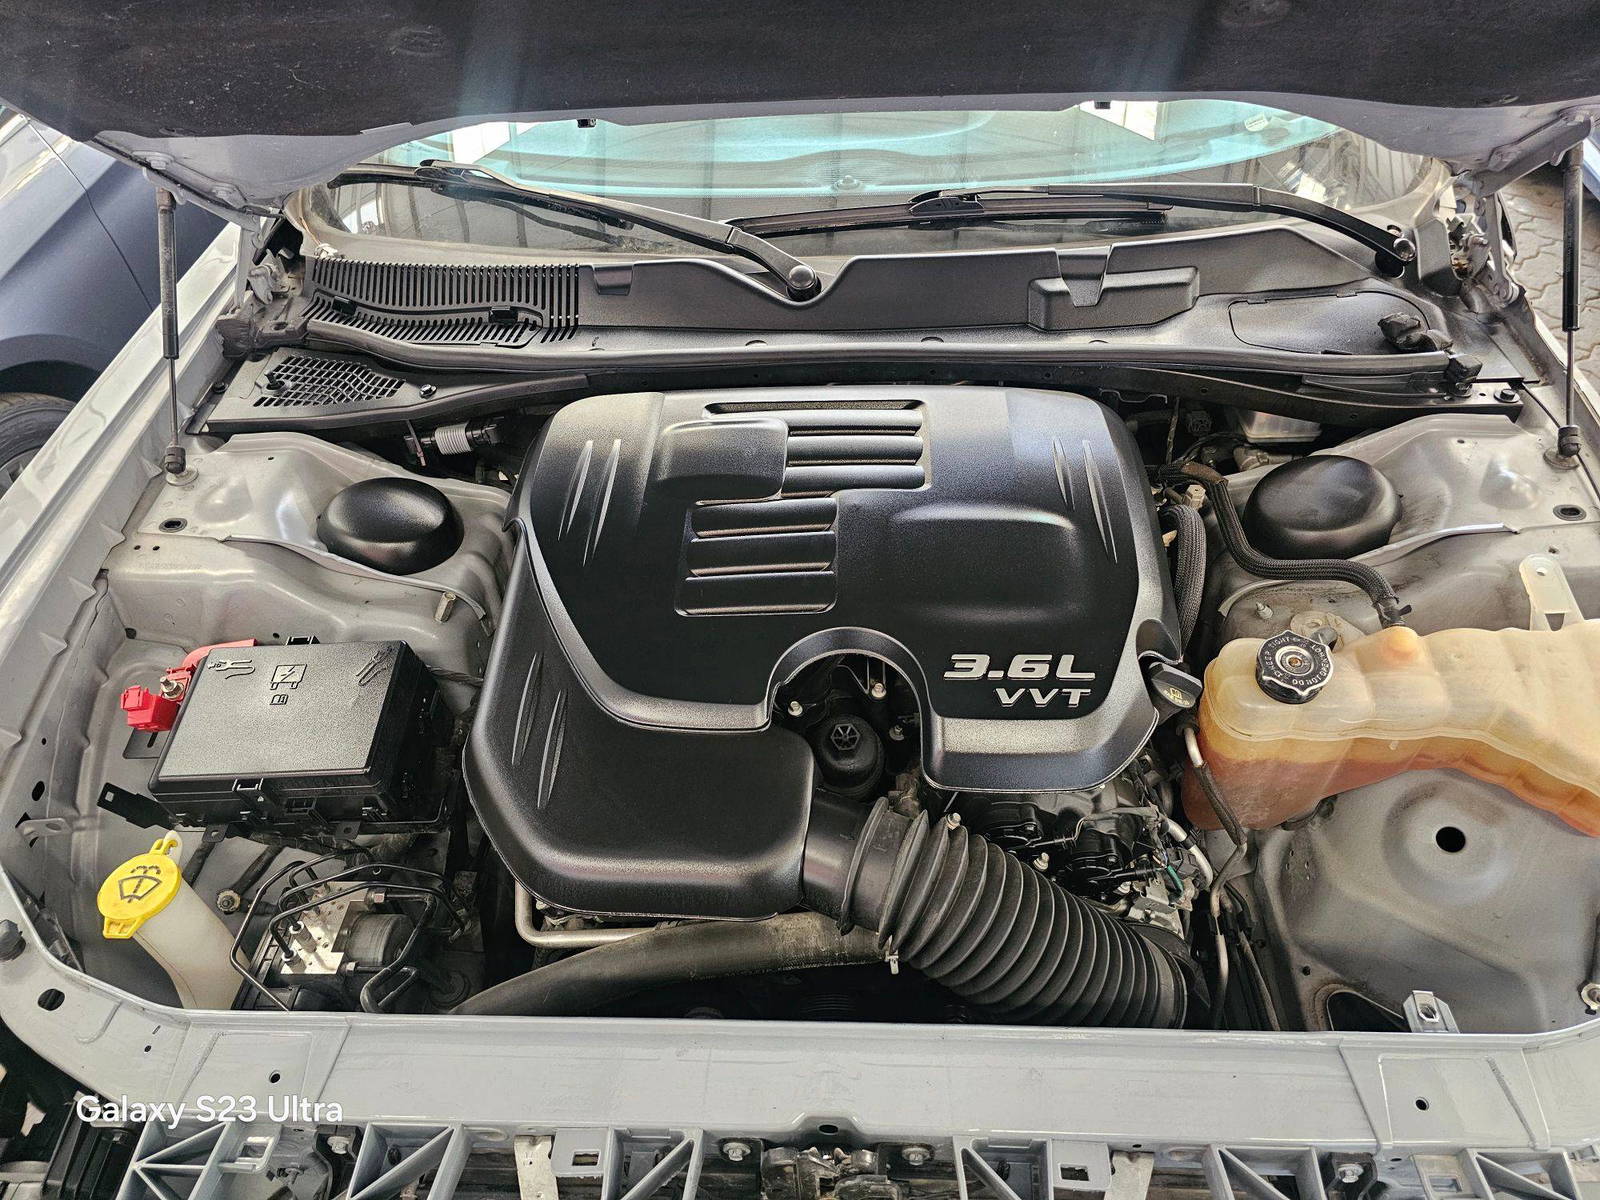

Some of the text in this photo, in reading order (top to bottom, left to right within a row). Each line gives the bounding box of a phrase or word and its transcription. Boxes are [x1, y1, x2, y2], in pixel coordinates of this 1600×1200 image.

[944, 654, 1096, 681] 3.6L
[1292, 678, 1305, 686] DO
[995, 687, 1091, 708] VVT
